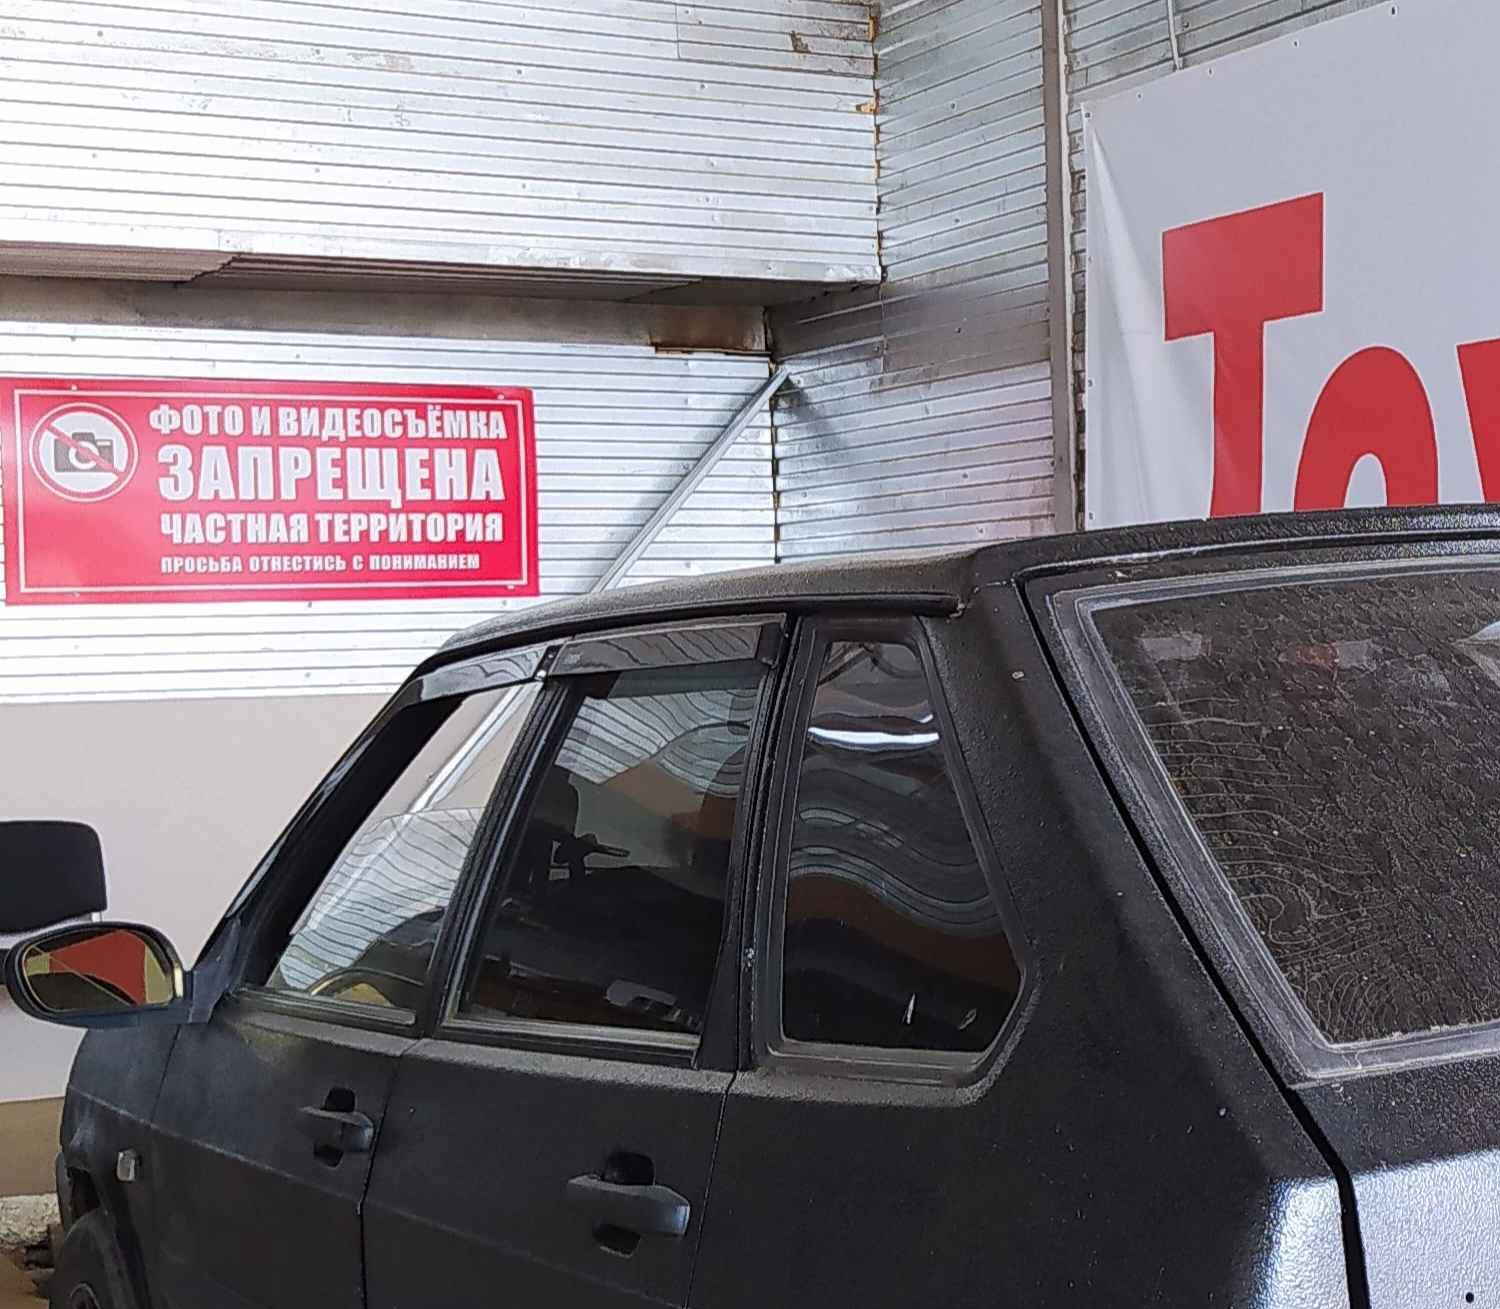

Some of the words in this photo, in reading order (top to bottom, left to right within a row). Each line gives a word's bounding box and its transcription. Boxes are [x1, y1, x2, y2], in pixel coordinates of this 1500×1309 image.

[149, 403, 244, 437] ФОТО
[250, 406, 272, 437] И
[280, 405, 508, 441] ВИДЕОСЪЁМКА
[158, 443, 506, 508] ЗАПРЕЩЕНА
[160, 512, 309, 544] ЧАСТНАЯ
[314, 512, 504, 543] ТЕРРИТОРИЯ
[160, 556, 243, 573] ПРОСЬБА
[248, 554, 347, 573] ОТНЕСТИСЬ
[351, 555, 365, 571] С
[368, 553, 481, 571] ПОНИМАНИЕМ
